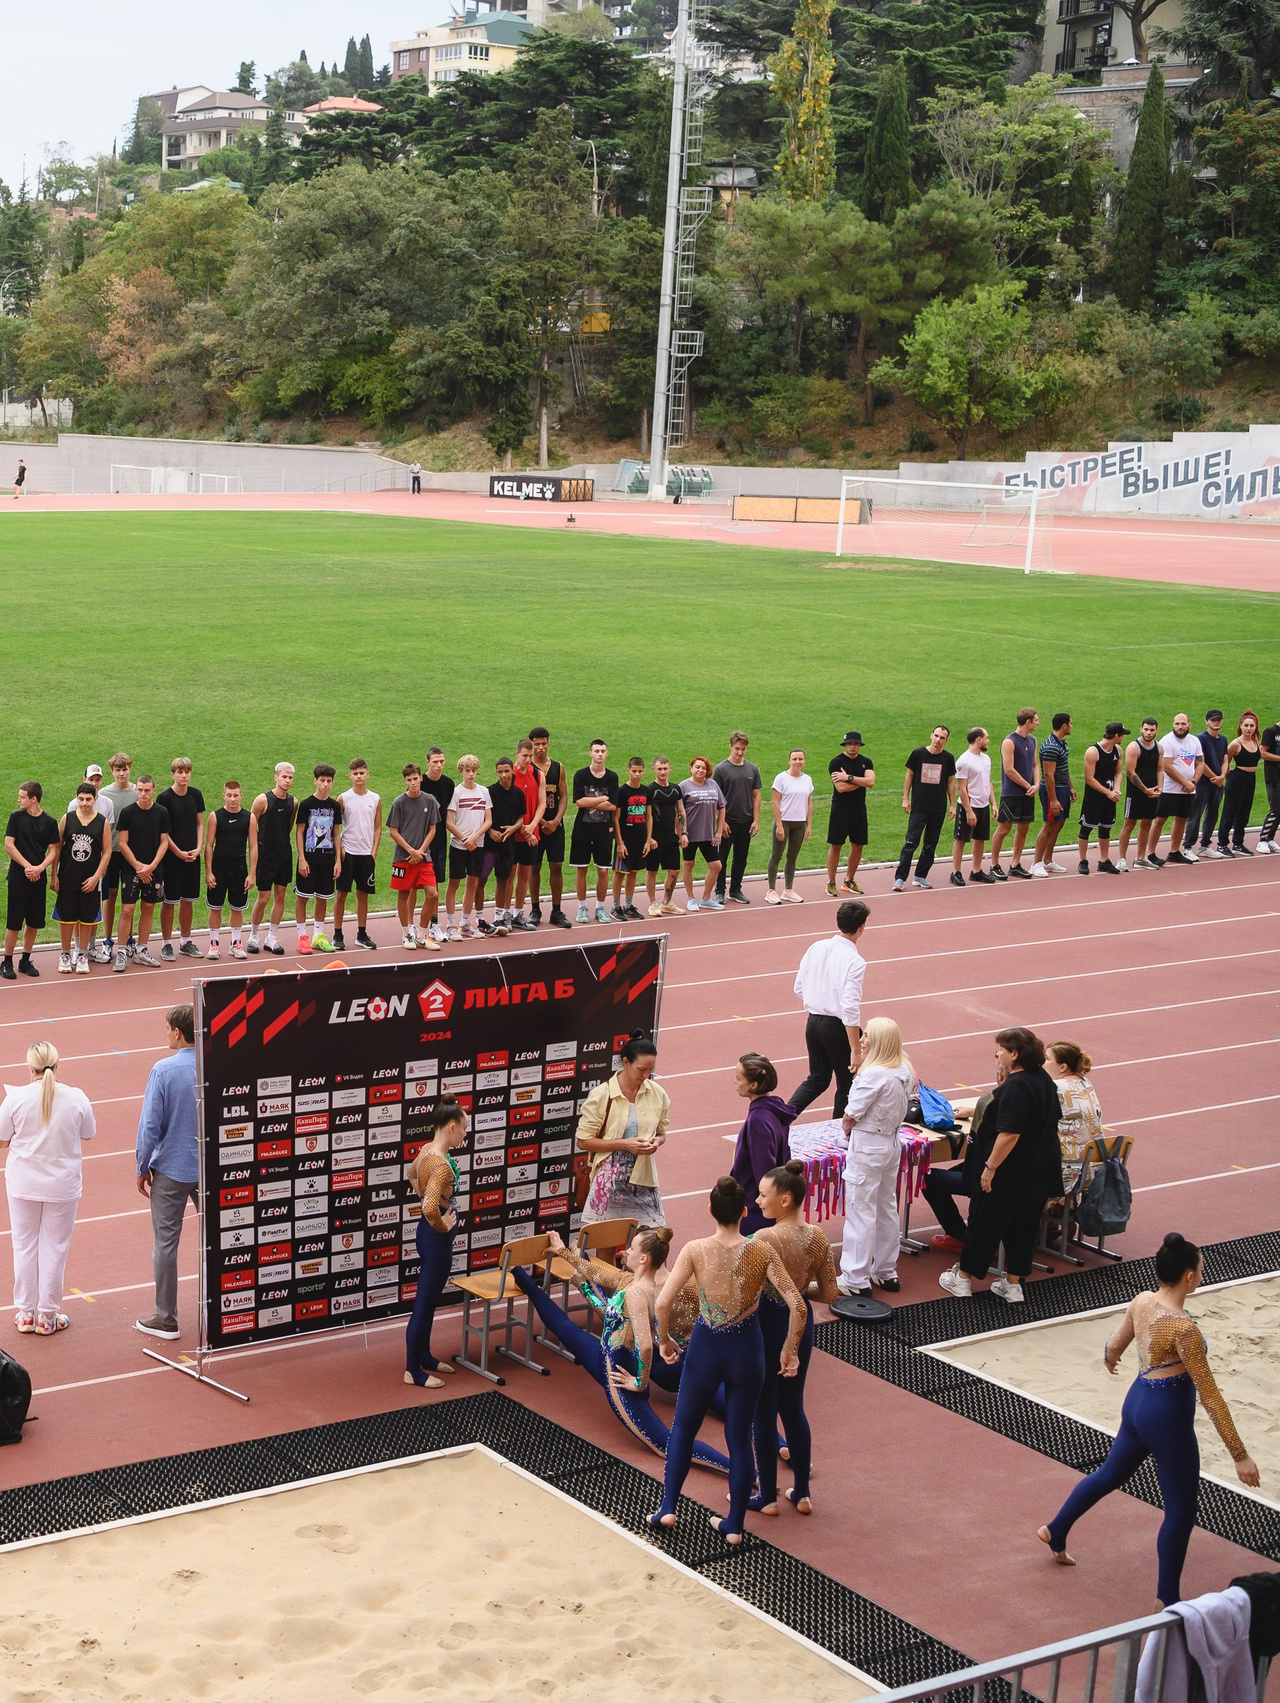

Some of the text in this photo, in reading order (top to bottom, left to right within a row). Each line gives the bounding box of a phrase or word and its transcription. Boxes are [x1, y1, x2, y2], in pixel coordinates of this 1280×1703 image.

[1004, 446, 1143, 498] БЫСТРЕЕ!
[1122, 449, 1232, 498] ВЫШЕ!
[494, 481, 542, 498] KELME
[72, 834, 94, 844] TOWN
[328, 979, 575, 1024] LEON 2 ЛИГА Б
[420, 1031, 452, 1042] 2024
[583, 1042, 607, 1052] LEON
[515, 1051, 540, 1061] LEON
[445, 1060, 470, 1070] LEON
[373, 1068, 399, 1078] LEON
[299, 1077, 326, 1087] LEON
[222, 1085, 250, 1096] LEON
[547, 1086, 571, 1095] LEON
[479, 1095, 504, 1105] LEON
[223, 1105, 249, 1118] LBL
[270, 1103, 289, 1111] МАЯК
[408, 1104, 434, 1115] LEON
[336, 1114, 362, 1124] LEON
[261, 1123, 288, 1134] LEON
[512, 1130, 536, 1140] LEON
[372, 1150, 397, 1160] LEON
[299, 1160, 325, 1171] LEON
[544, 1163, 567, 1173] LEON
[223, 1170, 250, 1181] LEON
[476, 1174, 501, 1185] LEON
[335, 1196, 361, 1206] LEON
[372, 1189, 395, 1202] LBL
[261, 1206, 288, 1217] LEON
[509, 1207, 532, 1218] LEON
[371, 1231, 396, 1241] LEON
[299, 1242, 325, 1253] LEON
[224, 1254, 251, 1265] LEON
[335, 1277, 360, 1288] LEON
[233, 1296, 252, 1304] МАЯК
[262, 1289, 288, 1300] LEON
[343, 1299, 361, 1307] МАЯК
